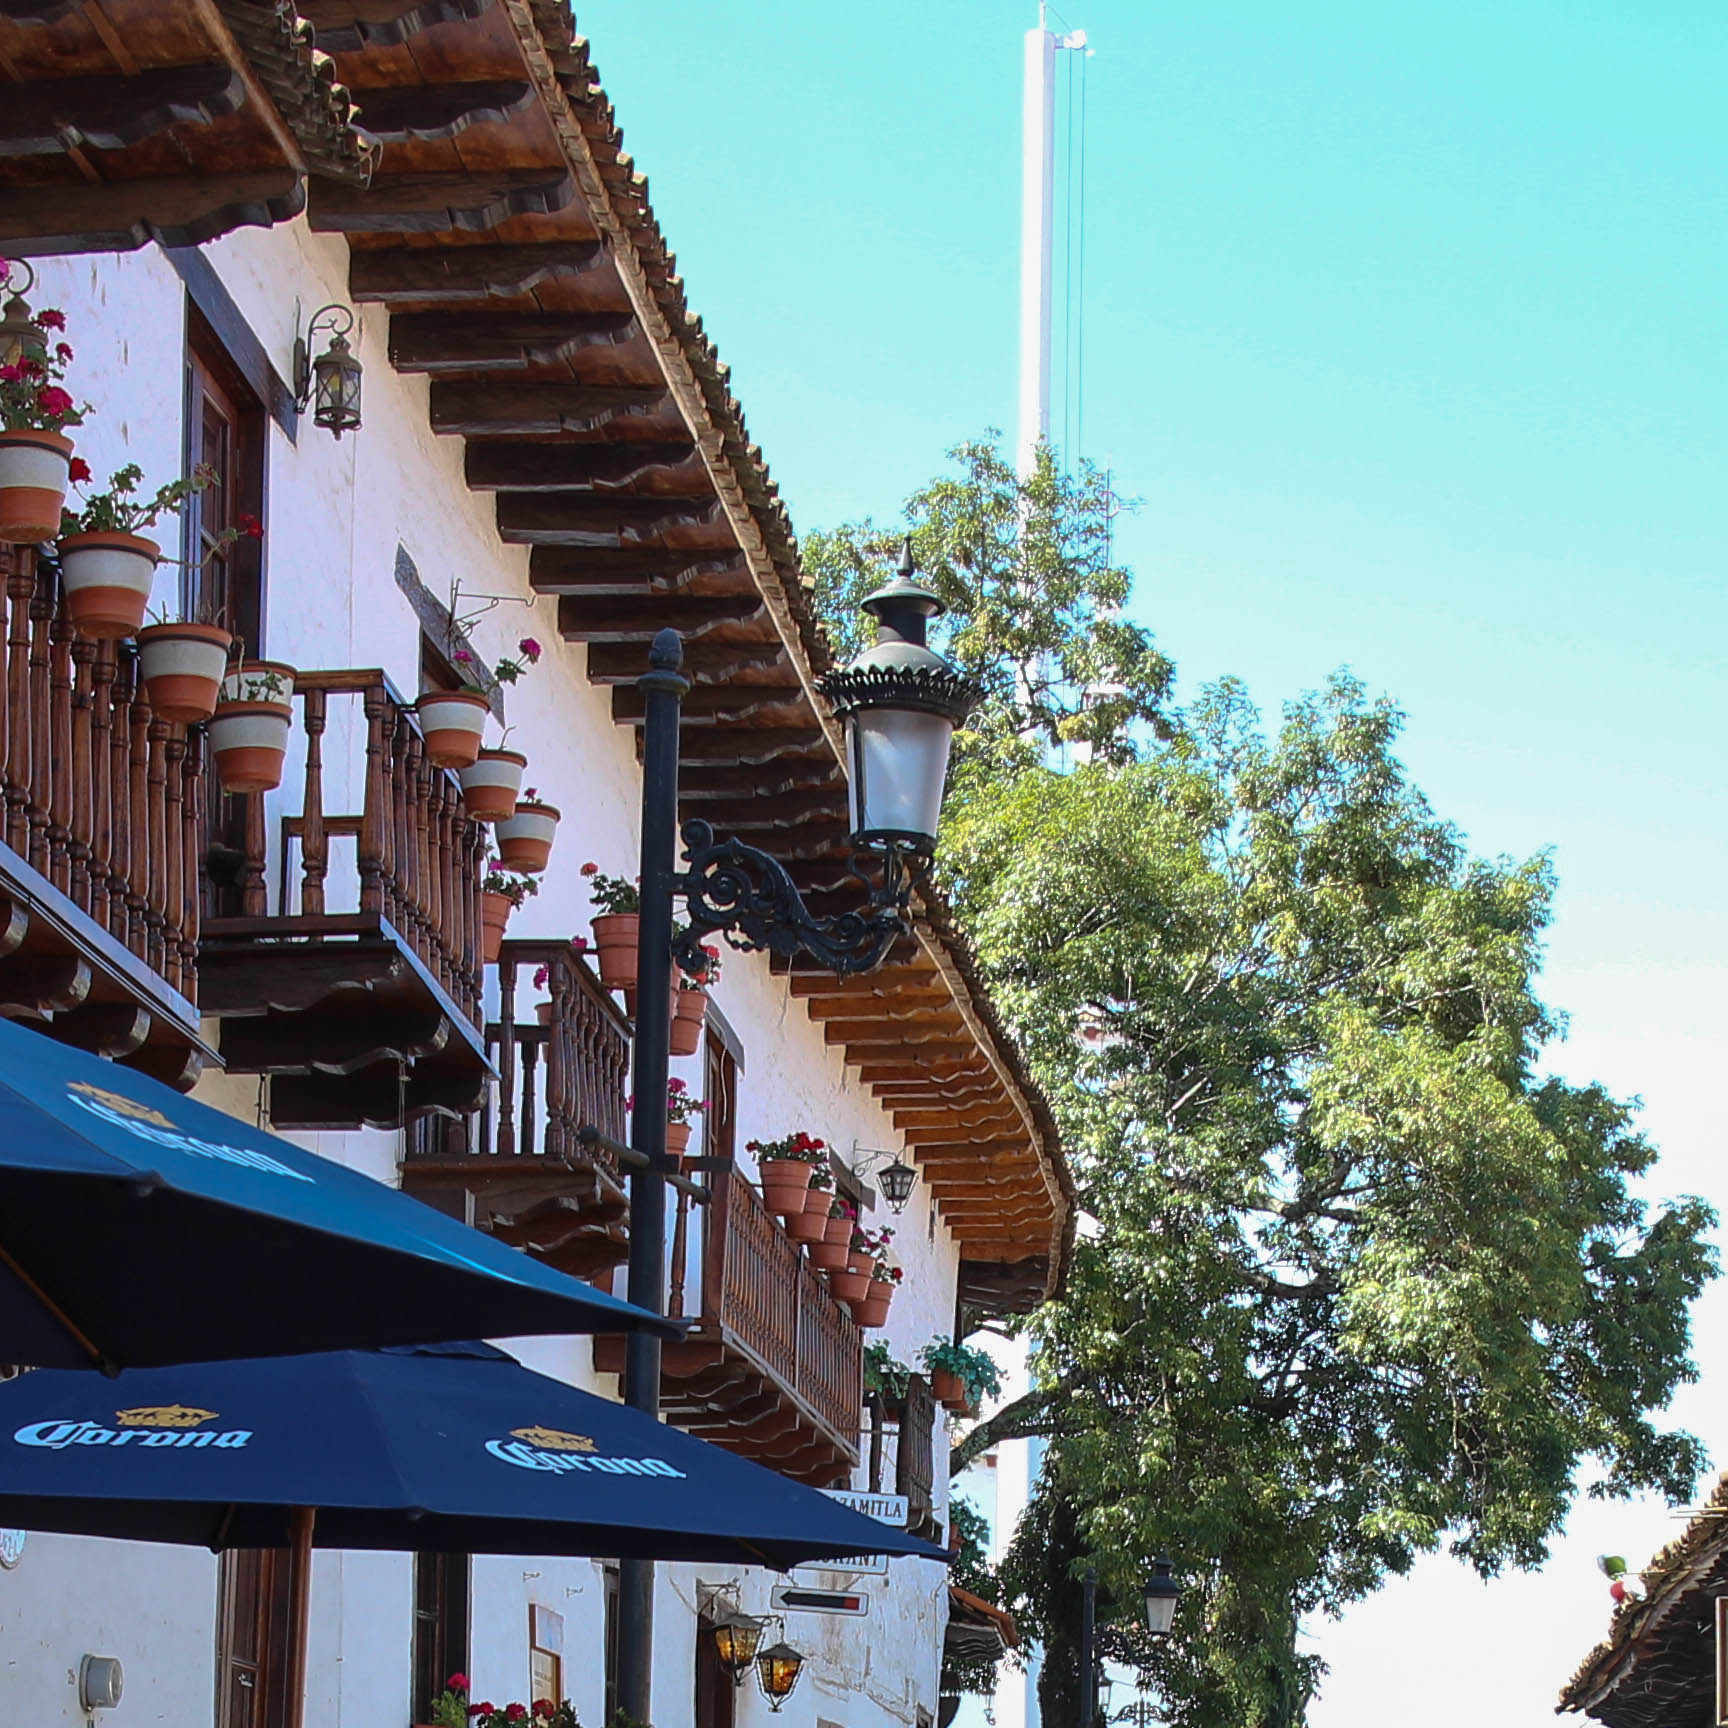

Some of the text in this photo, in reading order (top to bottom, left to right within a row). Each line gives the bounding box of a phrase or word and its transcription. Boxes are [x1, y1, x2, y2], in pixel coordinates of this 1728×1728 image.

[66, 1093, 317, 1184] Corona
[14, 1420, 254, 1450] Corona
[485, 1439, 688, 1479] Corona
